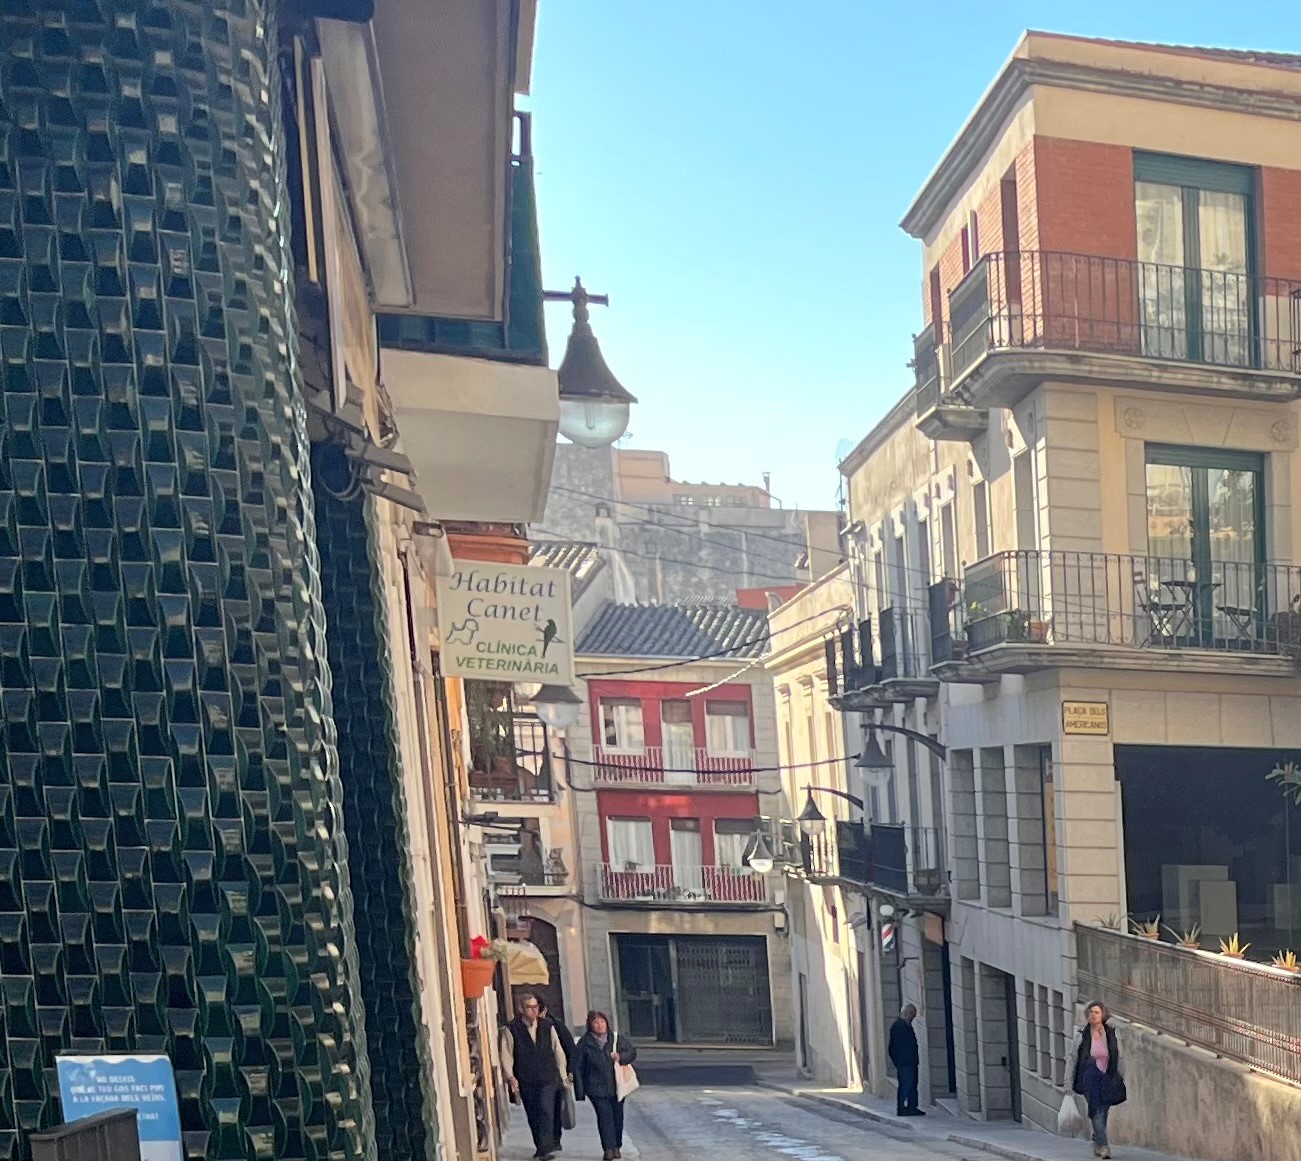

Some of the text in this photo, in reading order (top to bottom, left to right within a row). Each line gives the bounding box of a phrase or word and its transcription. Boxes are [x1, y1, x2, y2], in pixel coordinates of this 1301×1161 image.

[449, 569, 556, 598] Habitat
[467, 597, 543, 622] Canet
[475, 639, 538, 657] CLÍNICA
